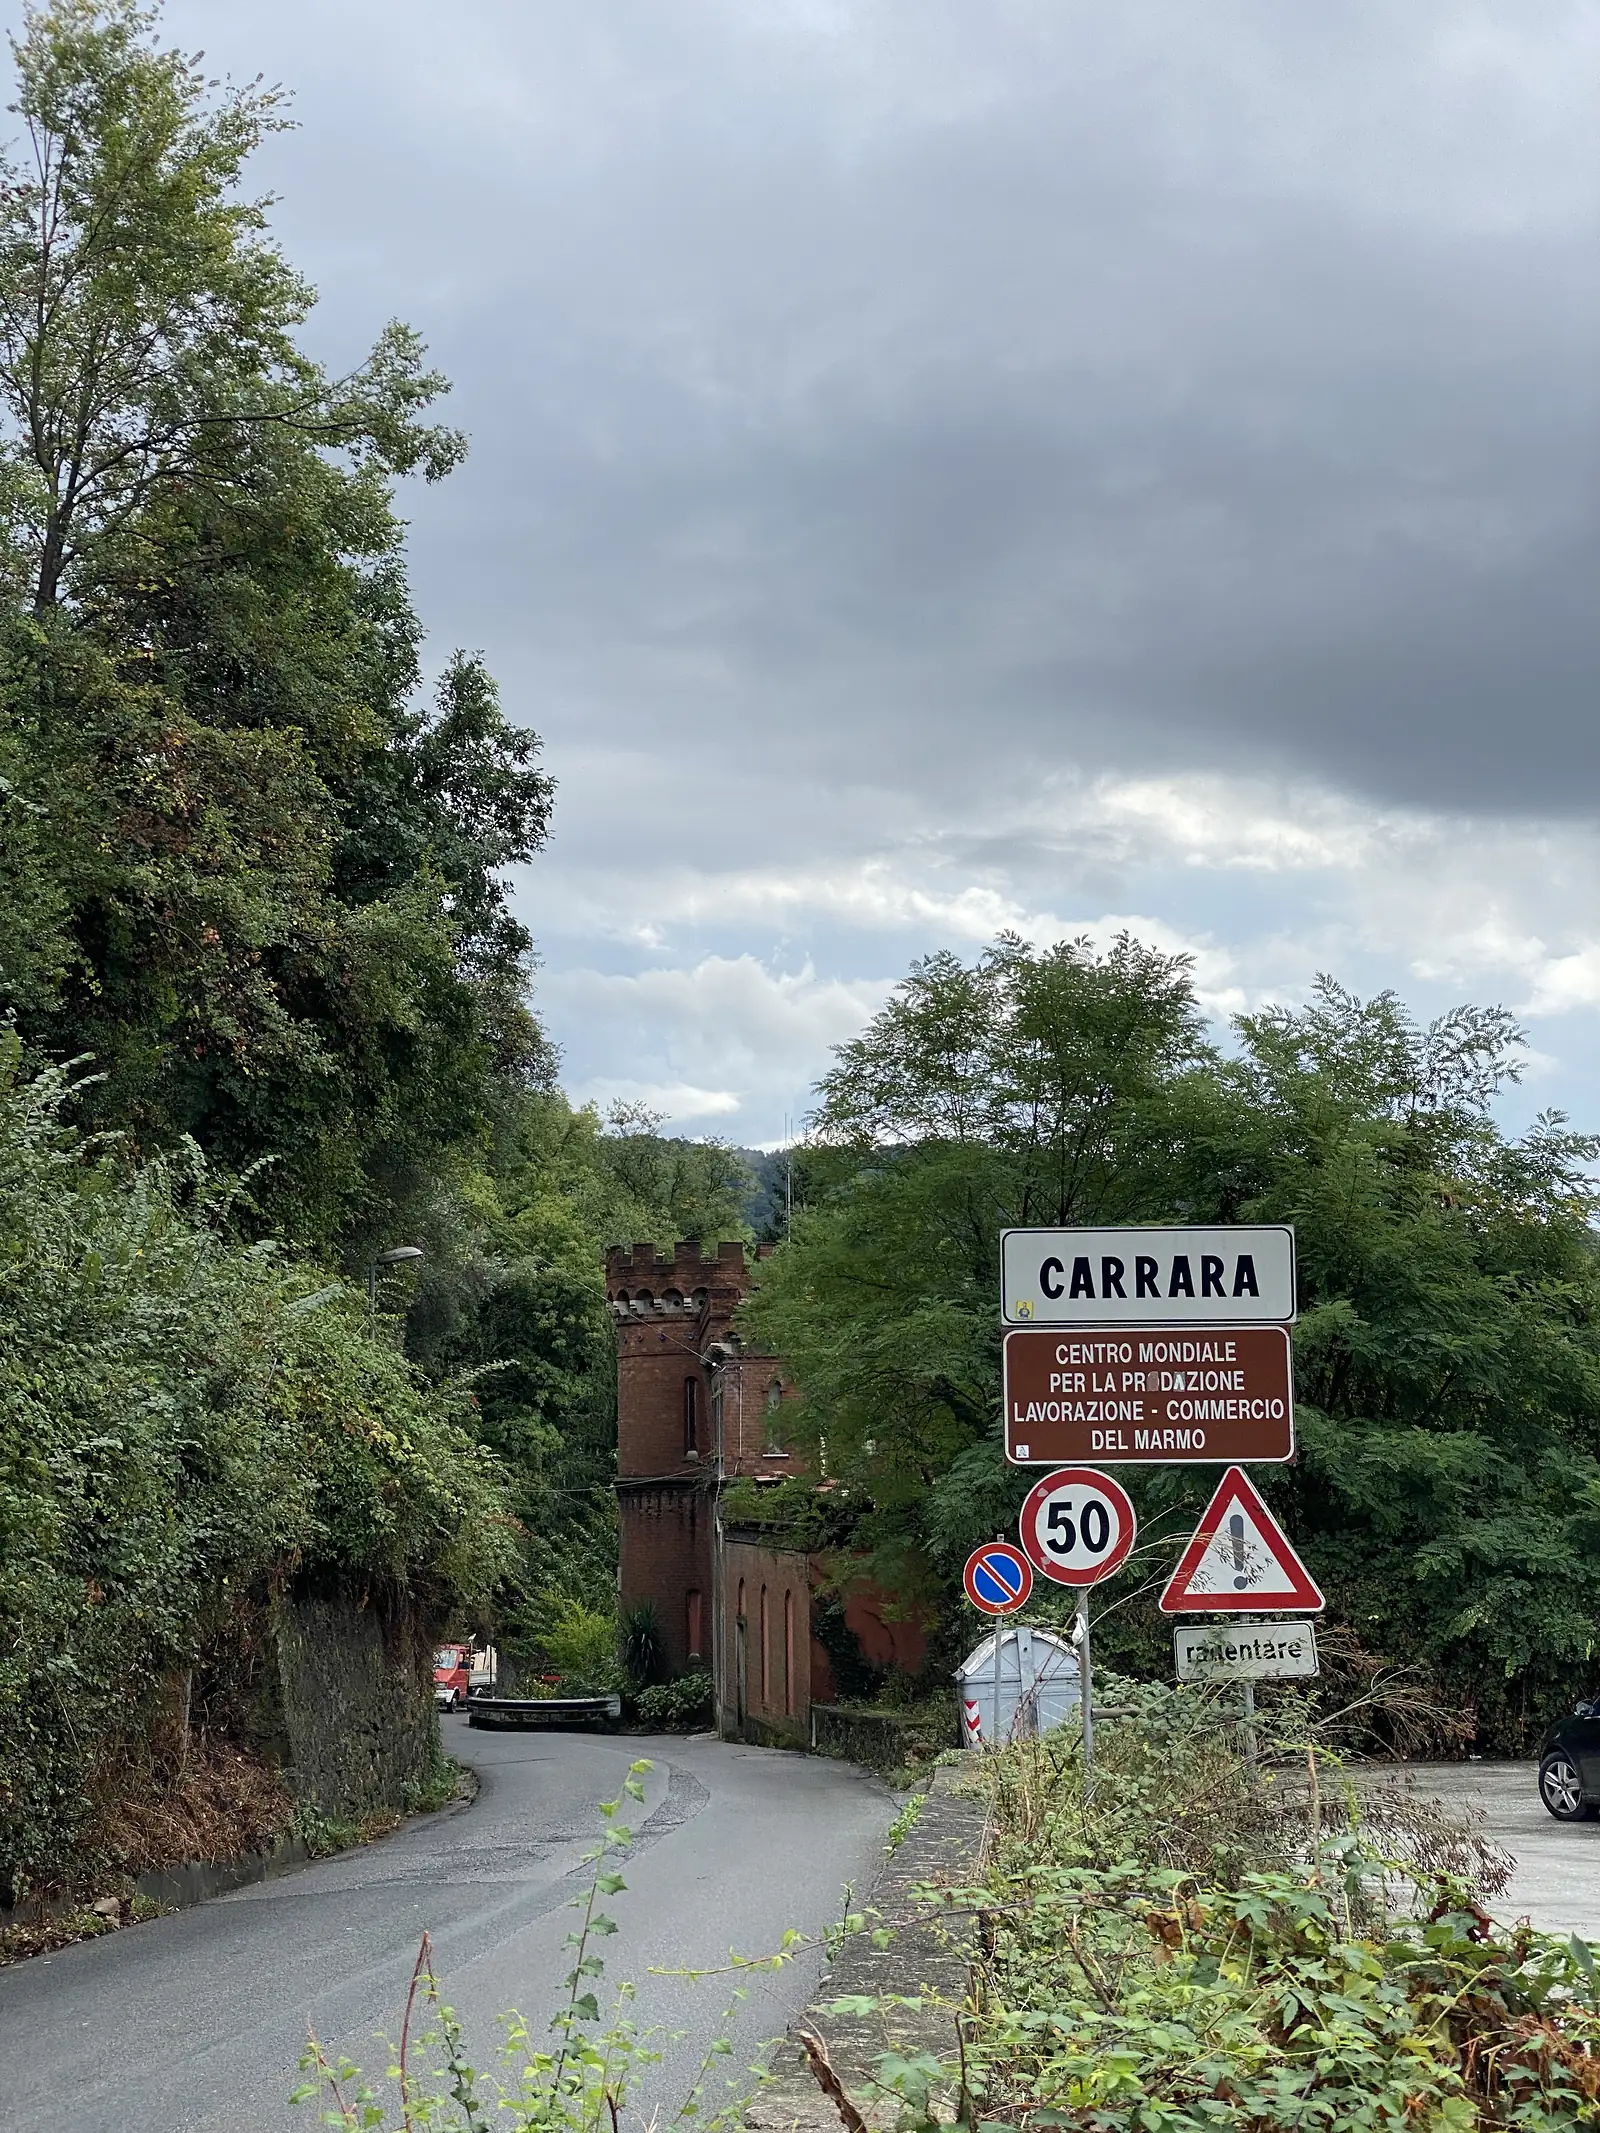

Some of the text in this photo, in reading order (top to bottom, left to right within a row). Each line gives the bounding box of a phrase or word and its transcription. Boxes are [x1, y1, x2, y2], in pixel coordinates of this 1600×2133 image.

[1039, 1254, 1260, 1300] CARRARA
[1055, 1341, 1237, 1365] CENTRO MONDIALE
[1049, 1372, 1086, 1393] PER
[1092, 1372, 1117, 1393] LA
[1014, 1400, 1145, 1422] LAVORAZIONE
[1166, 1398, 1285, 1421] COMMERCIO
[1091, 1428, 1206, 1451] DEL MARMO
[1046, 1499, 1110, 1555] 50
